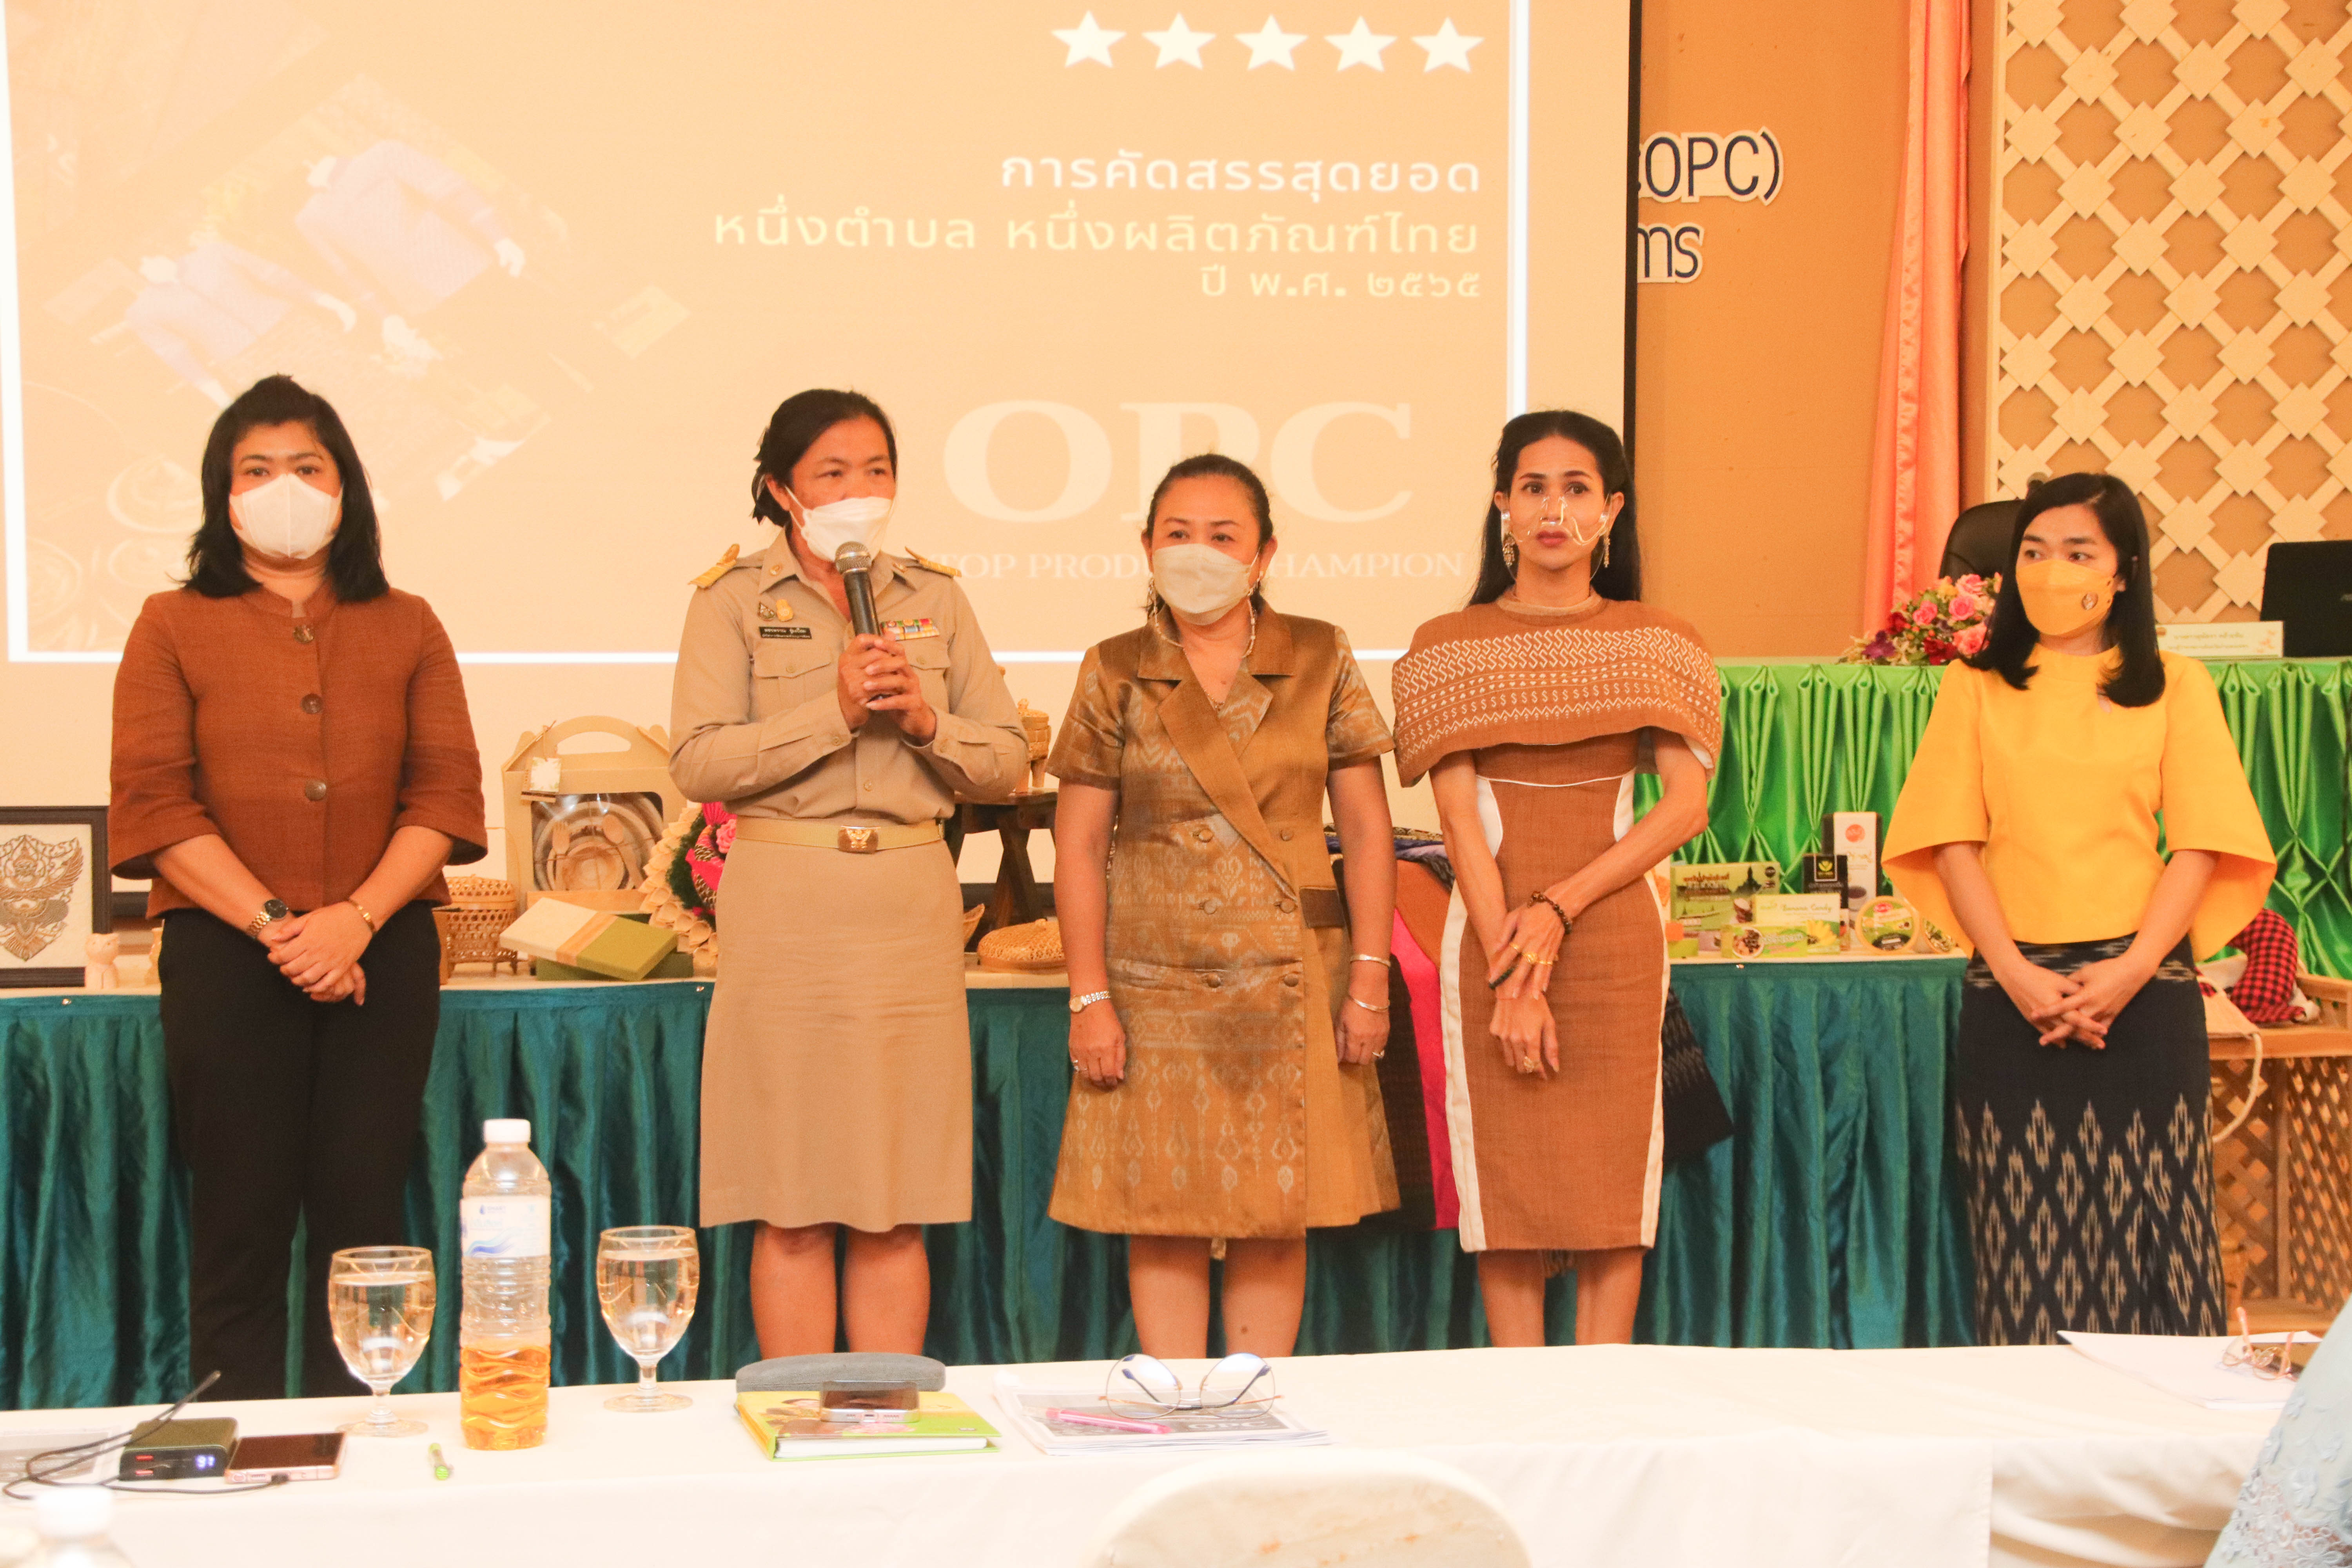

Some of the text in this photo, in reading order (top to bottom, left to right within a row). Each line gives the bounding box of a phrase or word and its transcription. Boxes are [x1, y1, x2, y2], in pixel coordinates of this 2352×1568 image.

[1001, 147, 1481, 203] การคัดสรรสุดยอด
[1639, 131, 1779, 200] OPC)
[715, 194, 1478, 253] หนึ่งตำบล หนึ่งผลิตภัณฑ์ไทย
[1201, 264, 1227, 297] ปี
[1249, 272, 1347, 298] พ.ศ.
[944, 399, 1413, 523] OPC
[929, 552, 1463, 579] TOP PROD HAMPION
